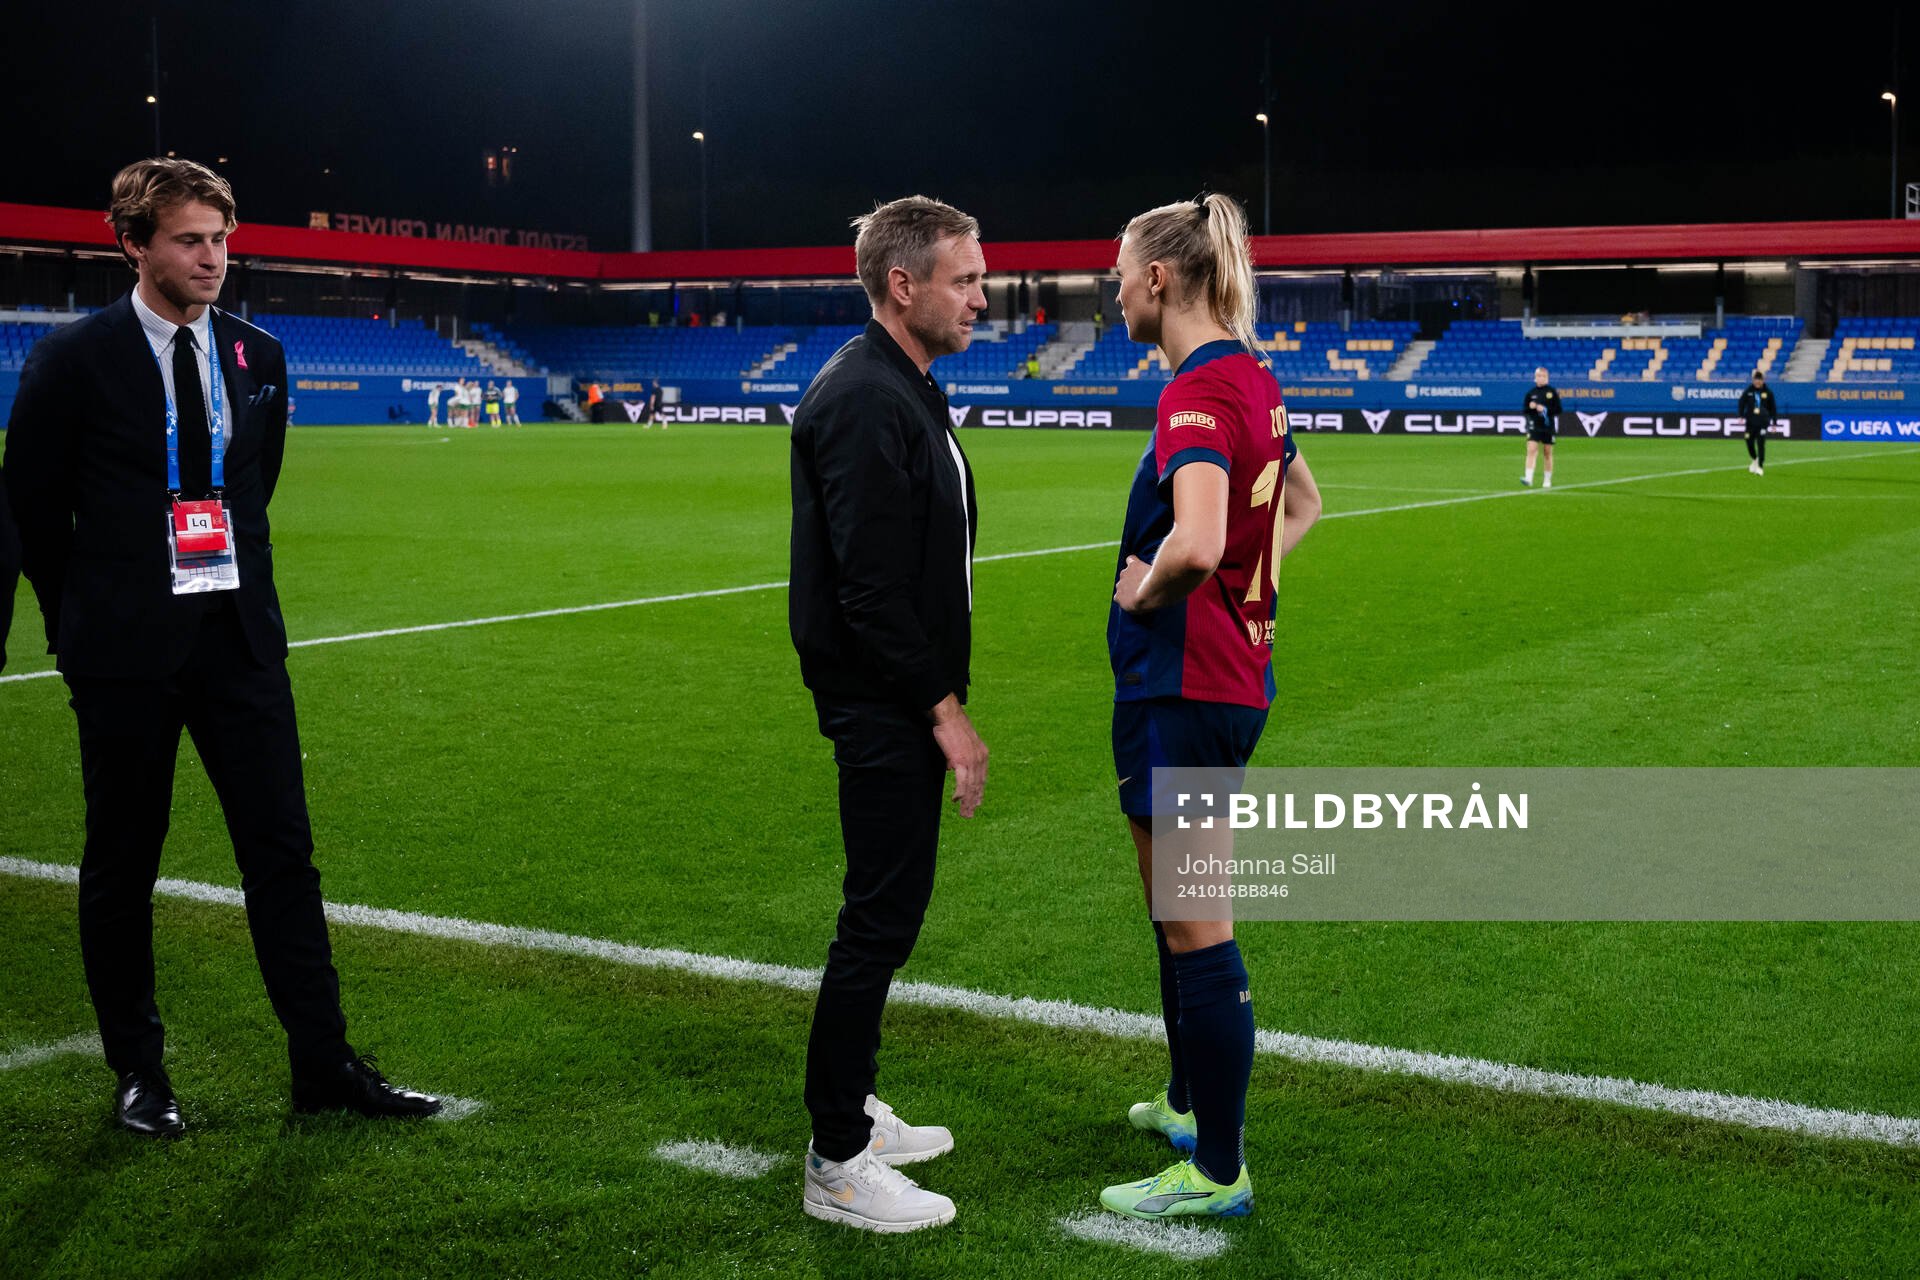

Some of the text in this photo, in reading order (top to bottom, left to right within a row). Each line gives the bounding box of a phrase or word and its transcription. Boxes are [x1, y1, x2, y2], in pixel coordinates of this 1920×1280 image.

[1420, 387, 1481, 397] FC BARCELONA
[1687, 388, 1698, 398] FC
[1840, 390, 1860, 400] QUE
[1862, 390, 1876, 399] UN
[1878, 390, 1904, 400] CLUB
[982, 410, 1112, 427] CUPRA
[1169, 412, 1216, 428] BIMBO
[1850, 420, 1893, 436] UEFA
[192, 518, 208, 528] Lq
